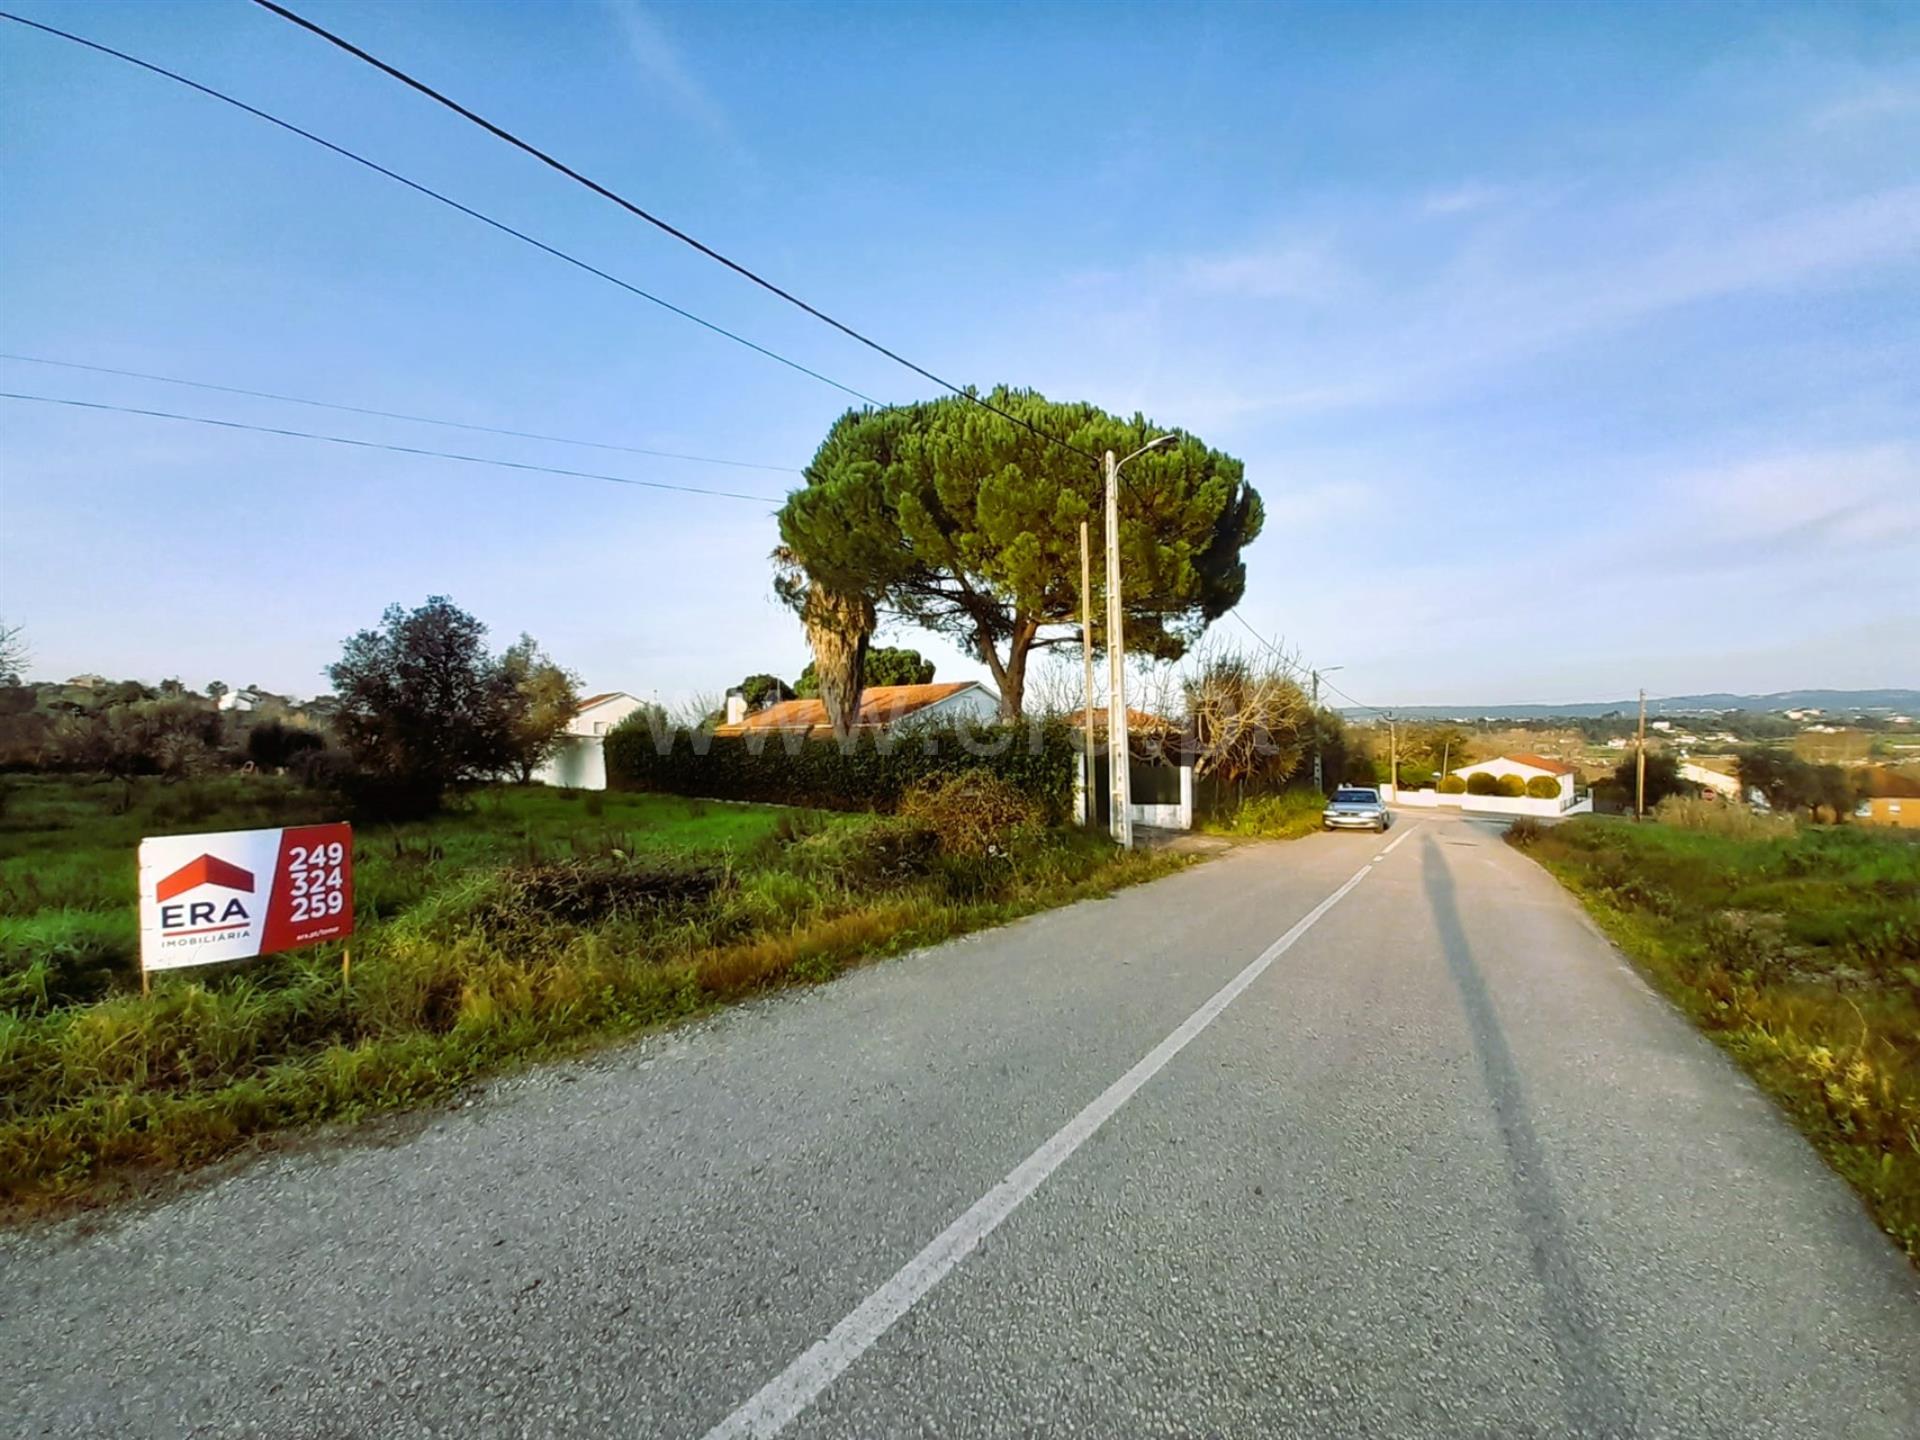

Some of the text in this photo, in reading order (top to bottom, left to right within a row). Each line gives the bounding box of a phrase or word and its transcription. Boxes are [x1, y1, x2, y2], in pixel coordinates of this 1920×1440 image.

[289, 842, 343, 872] 249
[290, 867, 343, 896] 324
[161, 898, 250, 928] ERA
[290, 890, 343, 922] 259
[161, 930, 250, 948] IMOBILIÁRIA
